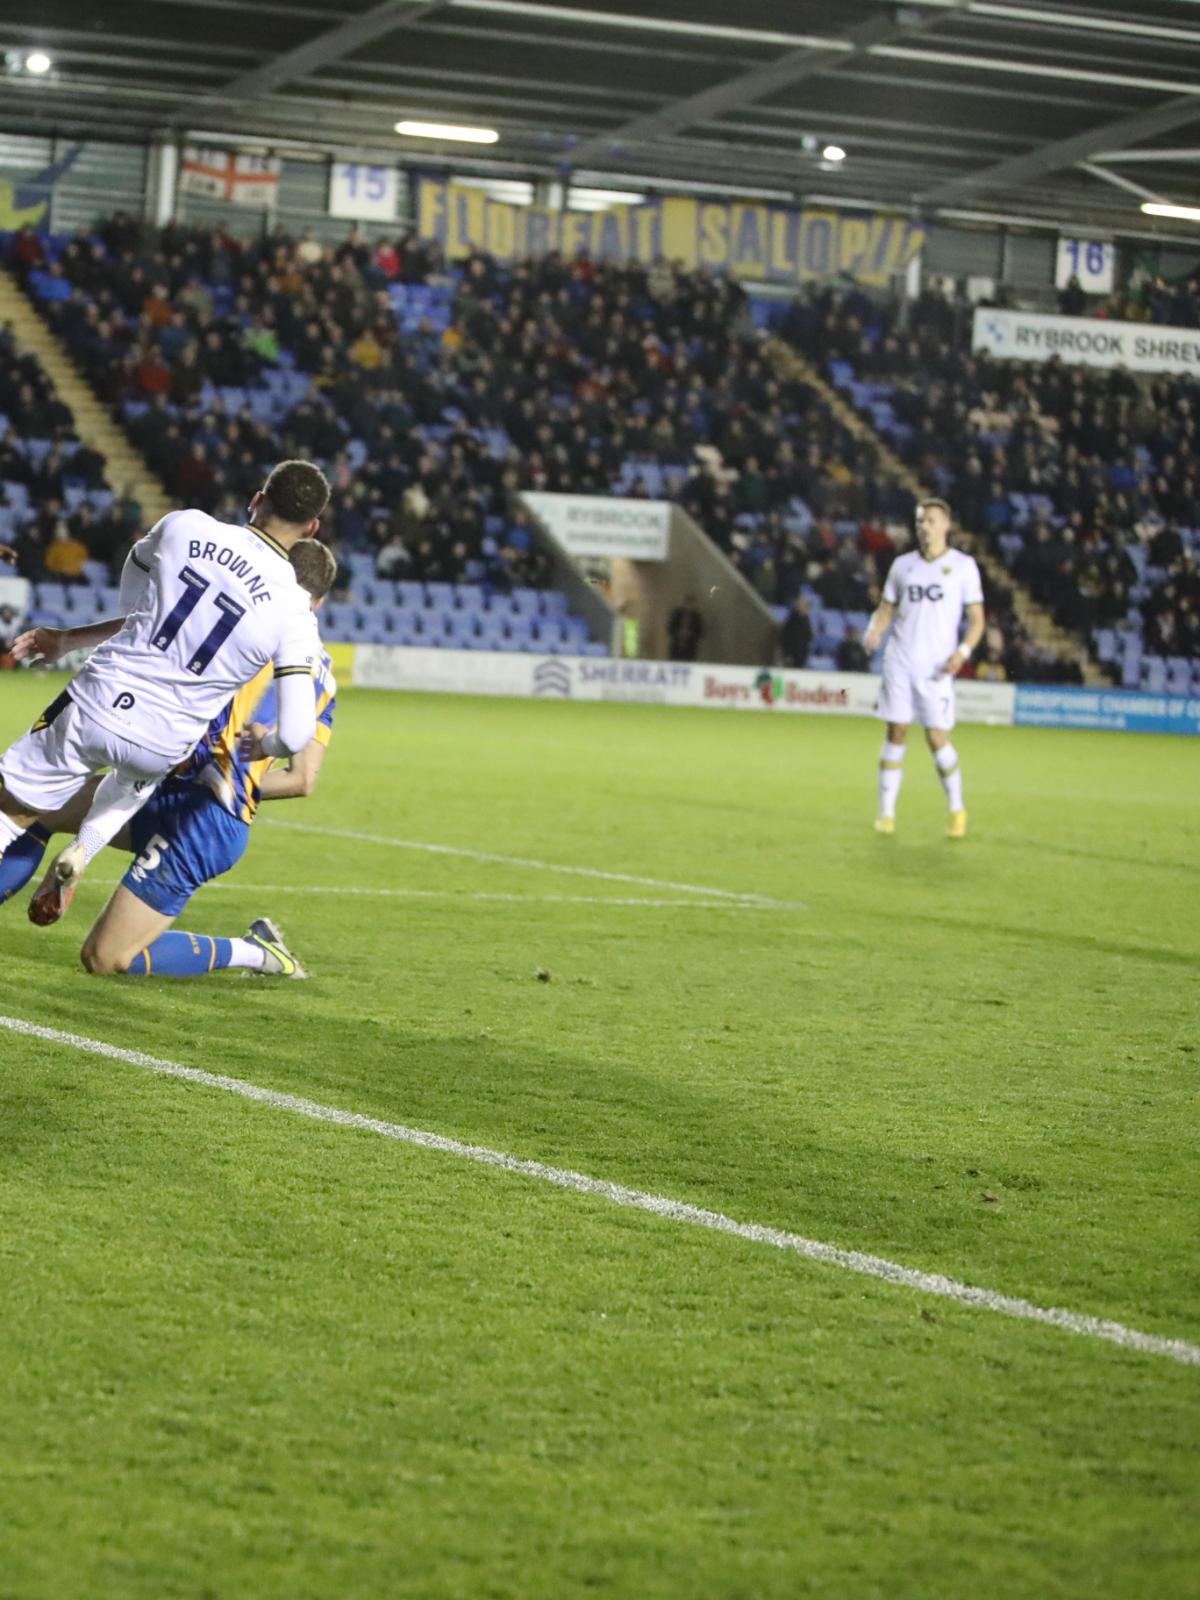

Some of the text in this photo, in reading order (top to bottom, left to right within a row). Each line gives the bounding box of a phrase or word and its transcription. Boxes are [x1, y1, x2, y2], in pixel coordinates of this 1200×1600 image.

[344, 163, 386, 201] 15
[1066, 239, 1105, 275] 16
[1014, 326, 1123, 355] RYBROOK
[188, 539, 272, 606] BROWNE
[907, 584, 945, 602] BG
[152, 564, 247, 677] 11
[578, 660, 692, 687] SHERRATT
[137, 832, 169, 871] 5
